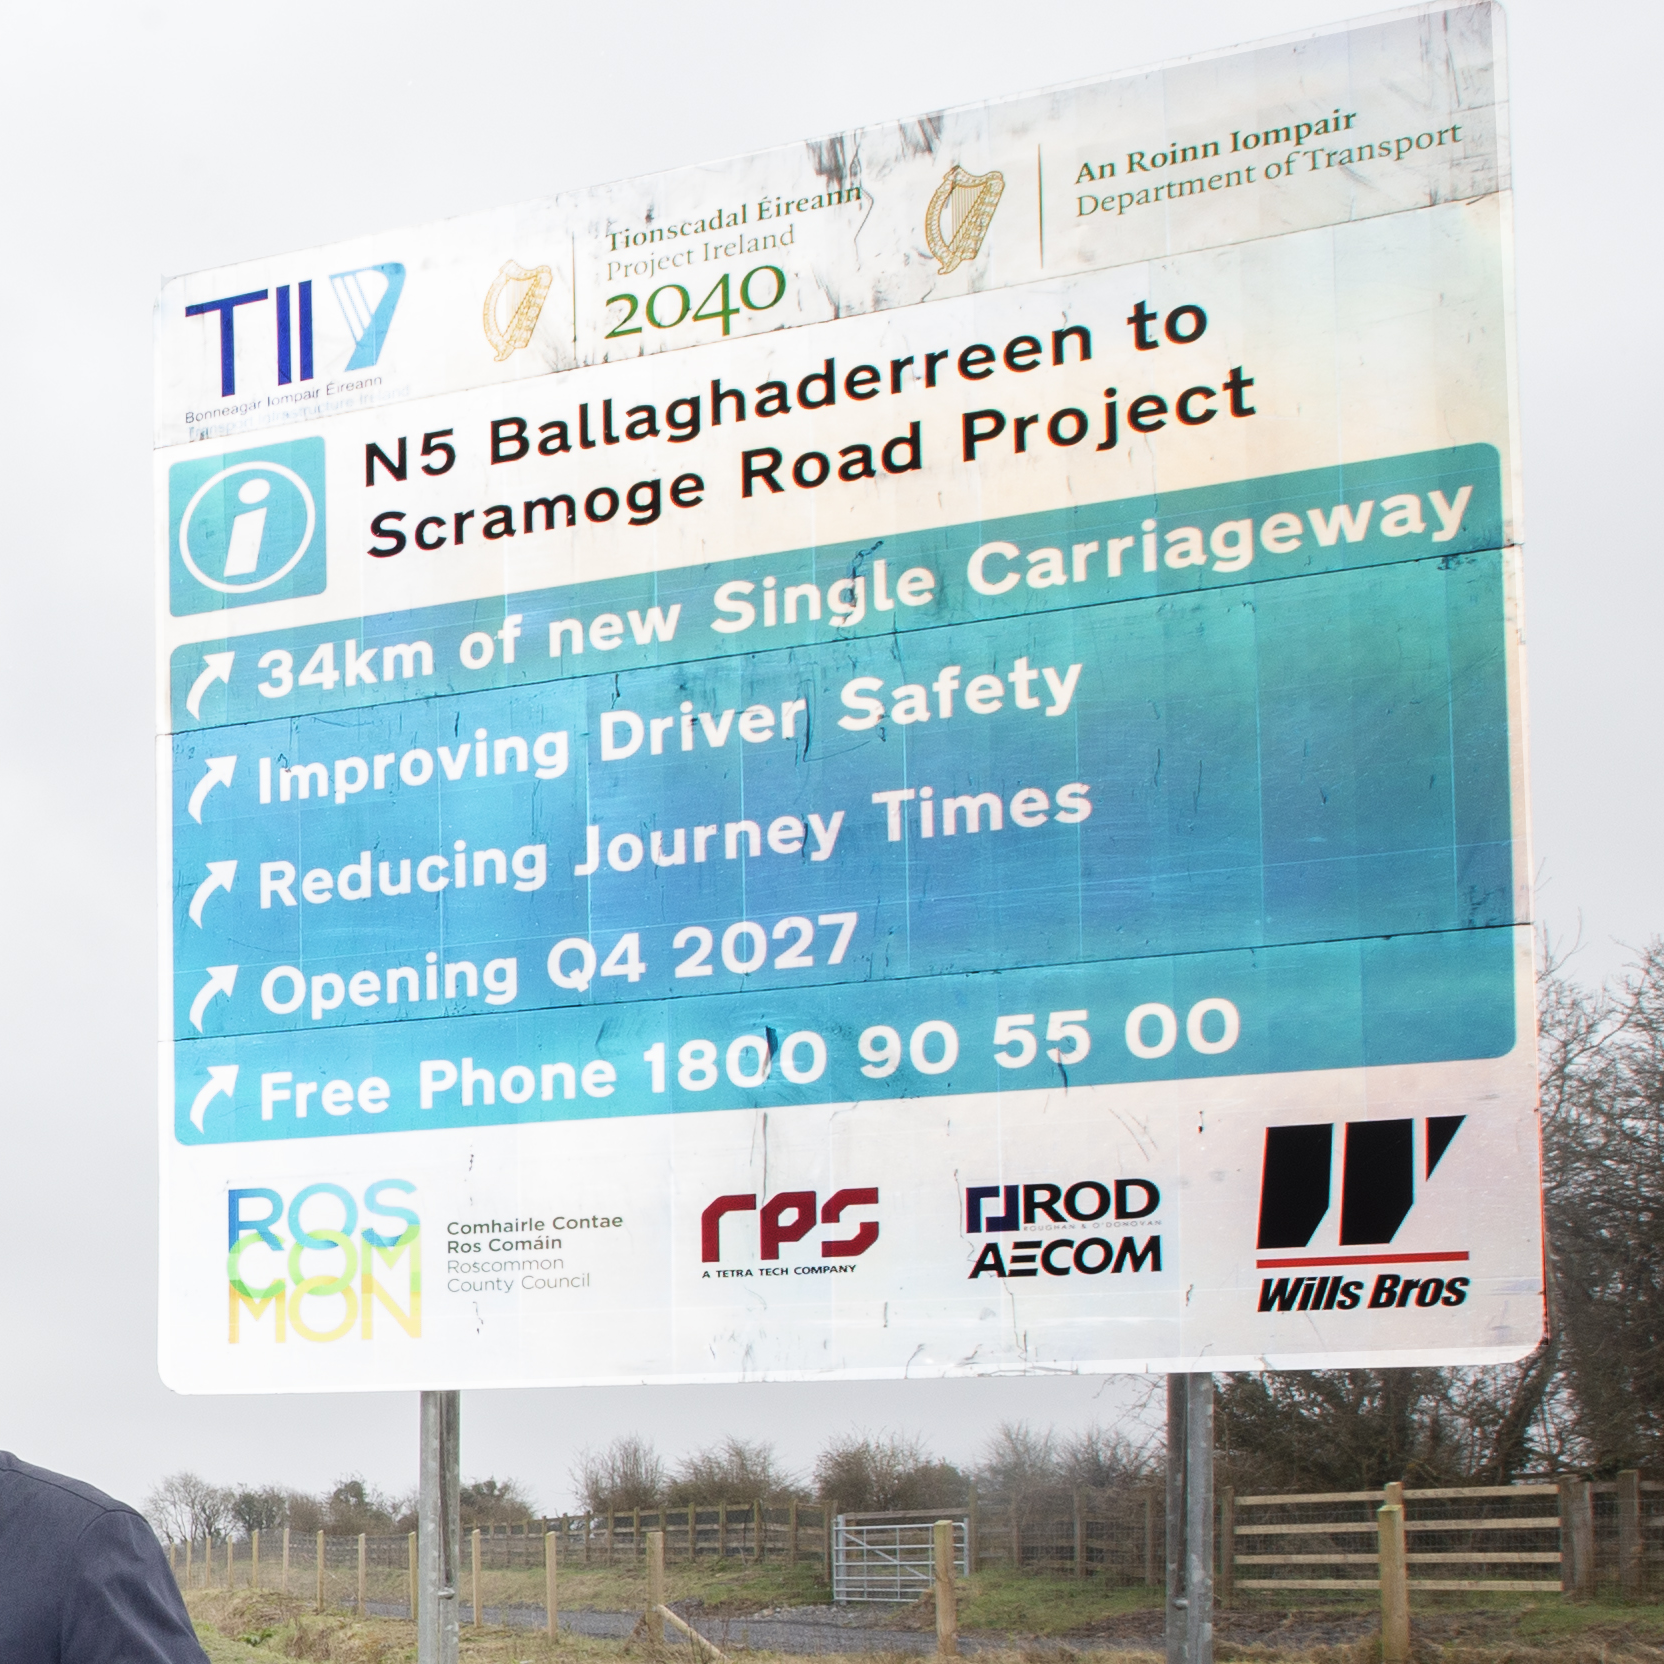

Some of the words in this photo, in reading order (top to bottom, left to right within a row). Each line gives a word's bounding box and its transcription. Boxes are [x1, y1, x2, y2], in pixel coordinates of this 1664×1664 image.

[1075, 157, 1116, 185] An
[1126, 137, 1219, 174] Roinn
[1229, 107, 1357, 153] Iompair
[1076, 167, 1256, 218] Department
[1263, 151, 1296, 182] of
[1299, 121, 1463, 178] Transport
[606, 203, 747, 252] Tionscadal
[757, 186, 862, 222] Éireann
[607, 248, 694, 281] Project
[703, 224, 795, 262] Ireland
[604, 265, 786, 338] 2040
[185, 399, 261, 424] Bonneagar
[268, 388, 321, 409] Iompair
[326, 376, 383, 397] Éireann
[365, 428, 457, 487] N5
[490, 324, 1092, 465] Ballaghaderreen
[1127, 300, 1207, 350] to
[367, 472, 704, 558] Scramoge
[741, 436, 922, 498] Road
[962, 366, 1256, 461] Project
[257, 639, 433, 698] 34km
[459, 615, 522, 669] of
[549, 603, 681, 658] new
[710, 556, 936, 633] Single
[966, 484, 1473, 596] Carriageway
[259, 728, 568, 804] Improving
[600, 696, 806, 762] Driver
[836, 656, 1082, 731] Safety
[259, 838, 547, 909] Reducing
[575, 811, 845, 876] Journey
[871, 782, 1092, 842] Times
[260, 951, 518, 1020] Opening
[547, 932, 645, 992] Q4
[674, 911, 858, 979] 2027
[260, 1071, 390, 1121] Free
[419, 1057, 616, 1109] Phone
[643, 1030, 827, 1093] 1800
[857, 1020, 959, 1079] 90
[993, 1009, 1091, 1070] 55
[1124, 997, 1240, 1060] 00
[228, 1178, 421, 1252] ROS
[447, 1218, 545, 1235] Comhairle
[552, 1215, 623, 1230] Contae
[1023, 1178, 1161, 1225] ROD
[447, 1240, 481, 1254] Ros
[488, 1235, 562, 1252] Comáin
[447, 1258, 564, 1274] Roscommon
[702, 1270, 711, 1279] A
[716, 1268, 753, 1278] TETRA
[758, 1267, 789, 1277] TECH
[794, 1264, 856, 1275] COMPANY
[968, 1235, 1162, 1279] AECOM
[228, 1274, 422, 1344] MON
[447, 1277, 514, 1293] County
[522, 1273, 590, 1290] Council
[1256, 1274, 1363, 1313] Wills
[1367, 1273, 1470, 1309] Bros
